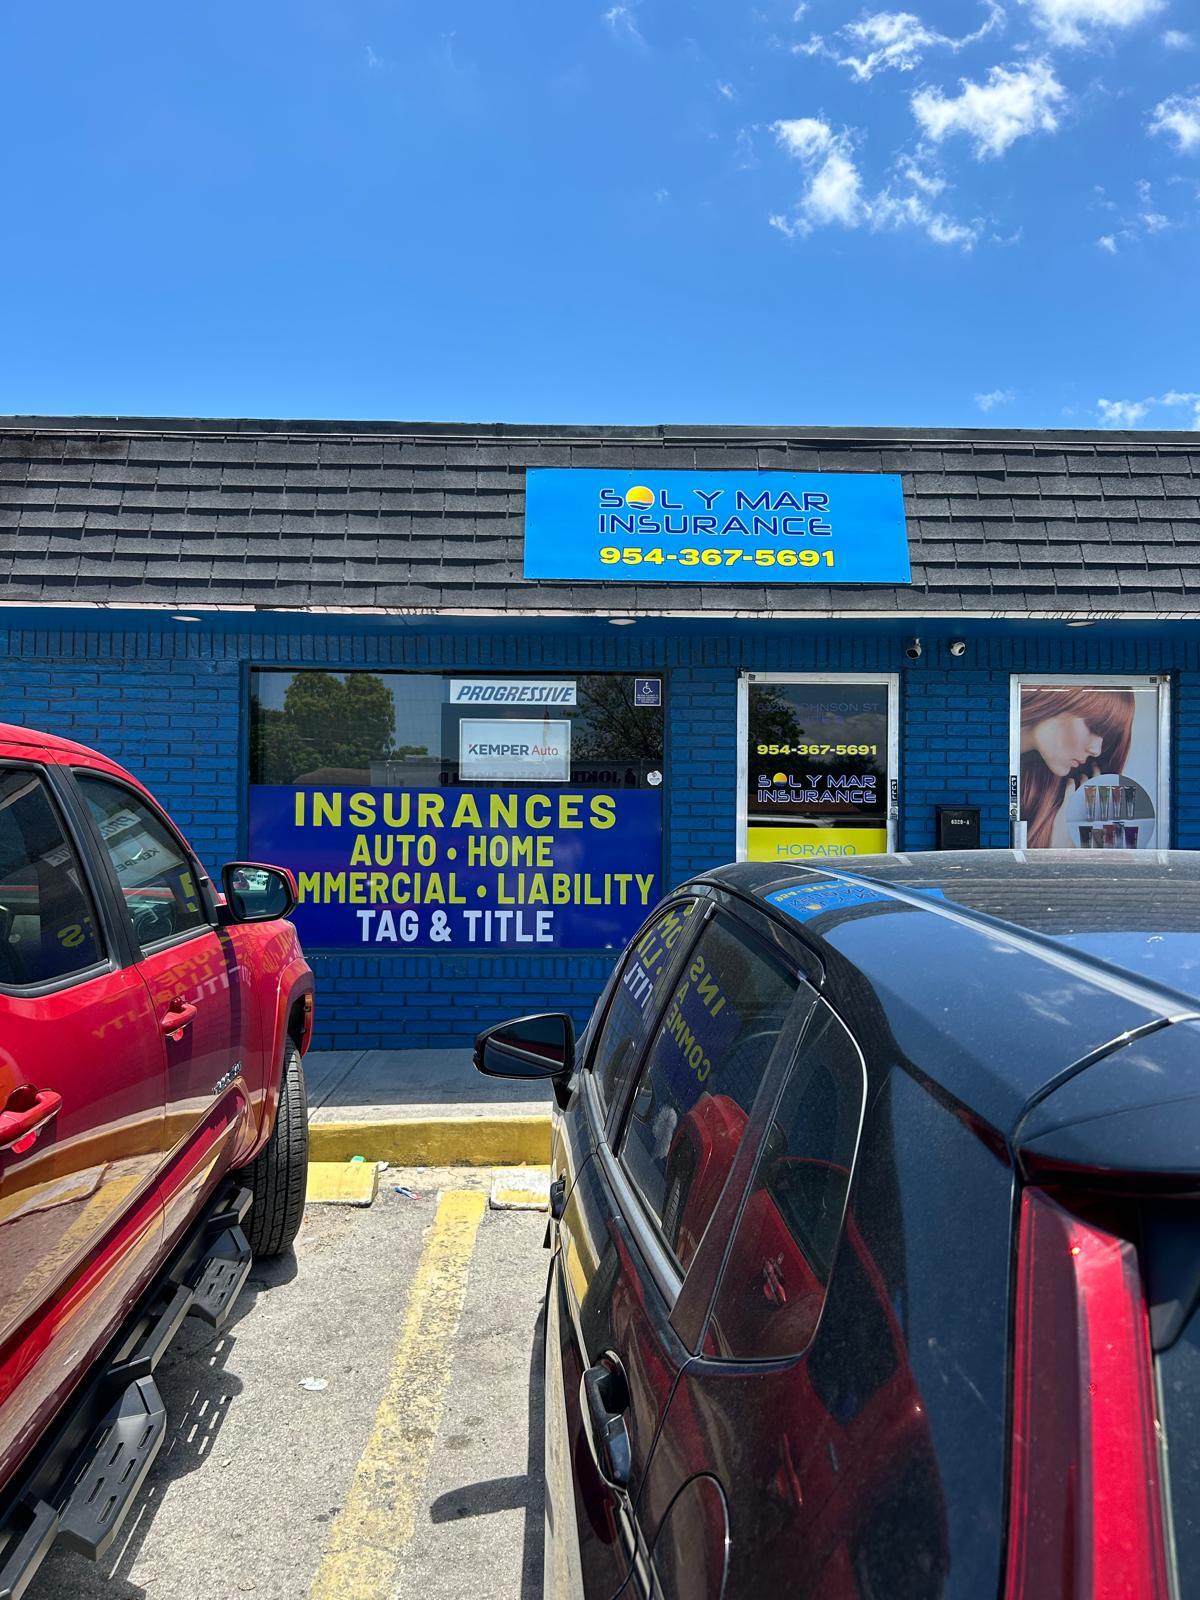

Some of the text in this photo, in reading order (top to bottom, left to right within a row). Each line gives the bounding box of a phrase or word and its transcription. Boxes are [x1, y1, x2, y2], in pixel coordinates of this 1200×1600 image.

[599, 485, 830, 513] SOL Y MAR
[598, 514, 834, 537] INSURANCE
[598, 546, 836, 568] 954-367-5691
[456, 685, 577, 703] PROGRESSIVE
[795, 703, 858, 712] OHNSON
[862, 703, 880, 712] ST
[468, 743, 560, 756] KEMPER Auto
[756, 744, 878, 756] 954-367-5691
[757, 772, 877, 789] SOL Y MAR
[757, 789, 878, 803] INSURANCE
[294, 791, 617, 830] INSURANCES
[350, 833, 554, 868] AUTO HOME
[776, 843, 856, 856] HORARIO
[298, 871, 655, 905] MMERCIAL LIABILITY
[356, 909, 555, 943] TAG & TITLE
